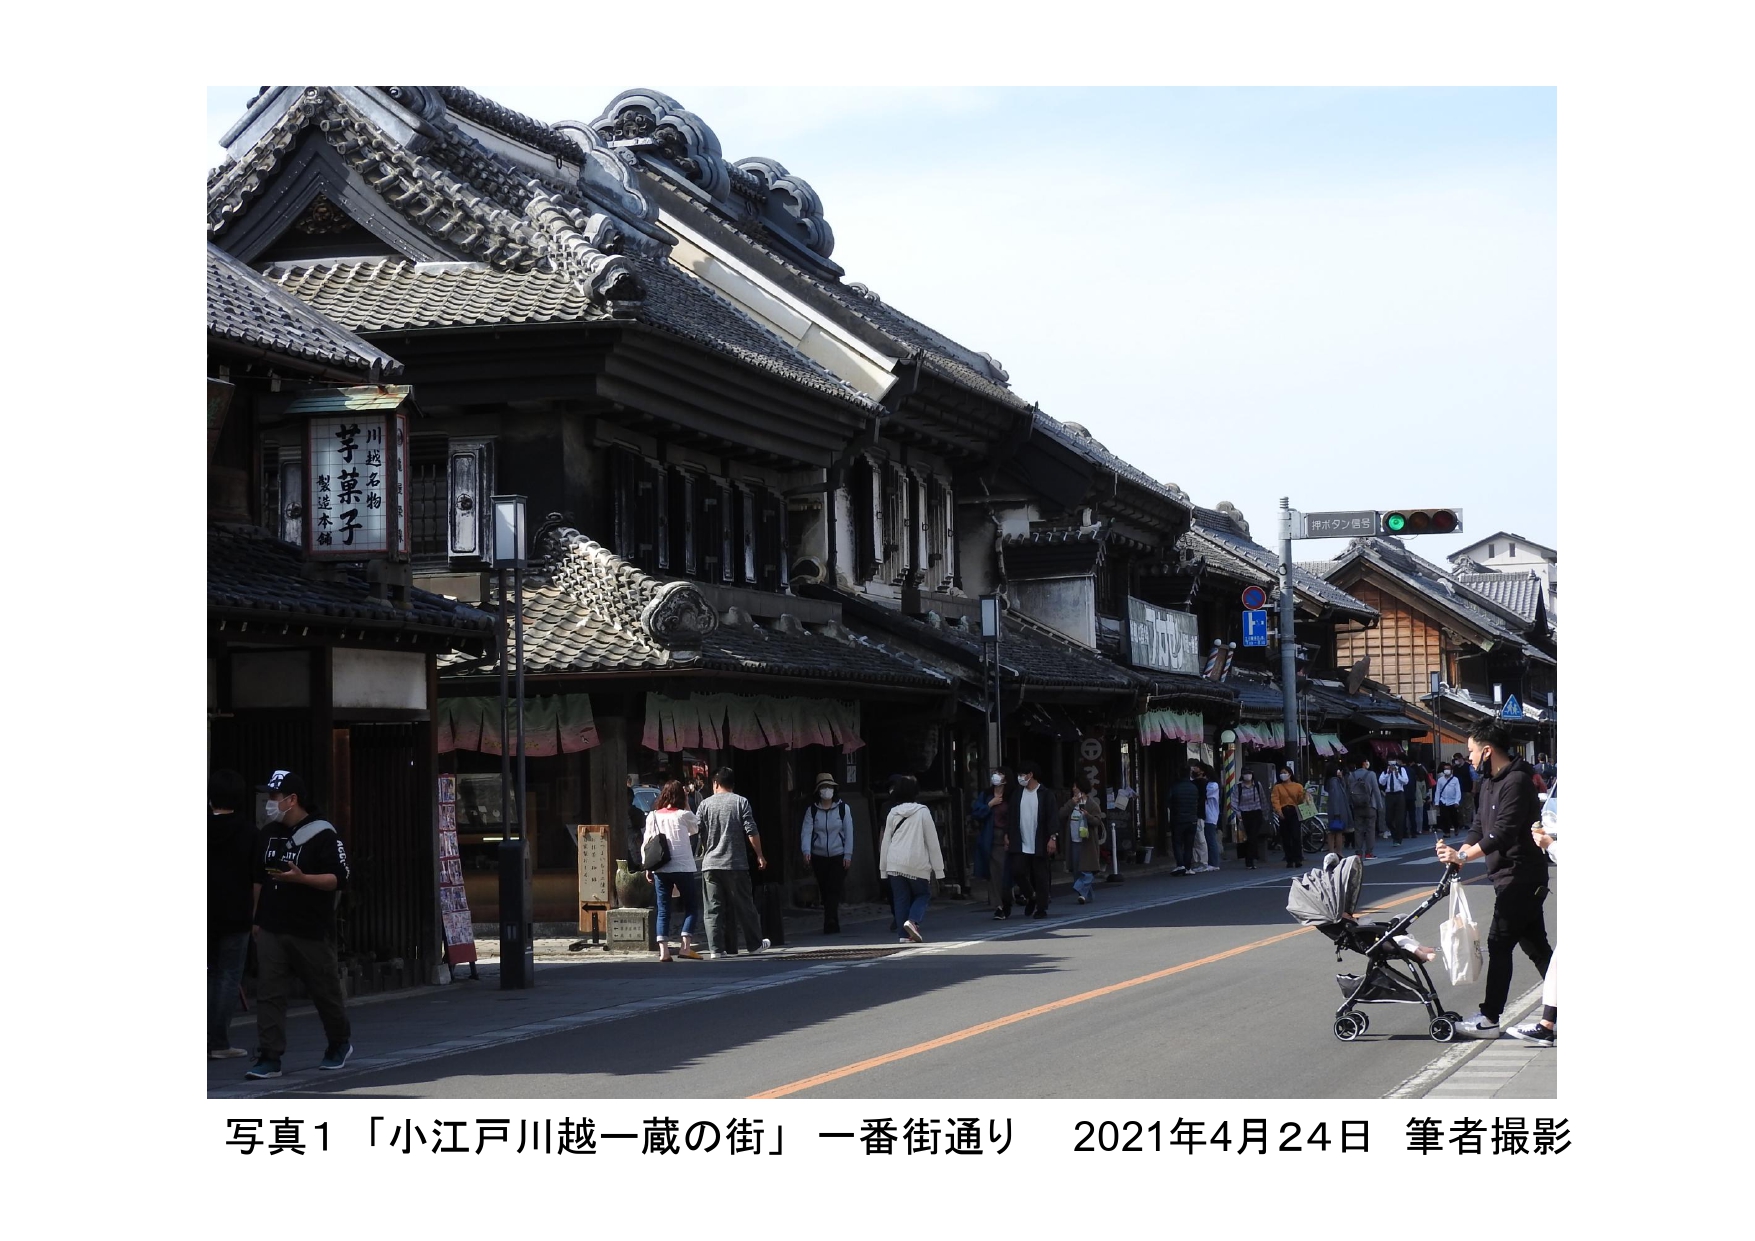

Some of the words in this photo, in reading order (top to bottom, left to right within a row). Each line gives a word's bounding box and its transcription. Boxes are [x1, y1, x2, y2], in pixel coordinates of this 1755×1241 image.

[335, 423, 363, 545] 芋菓子
[366, 426, 381, 509] 川越名物
[316, 474, 333, 546] 製造本舗
[1311, 518, 1371, 531] 押ボタン信号
